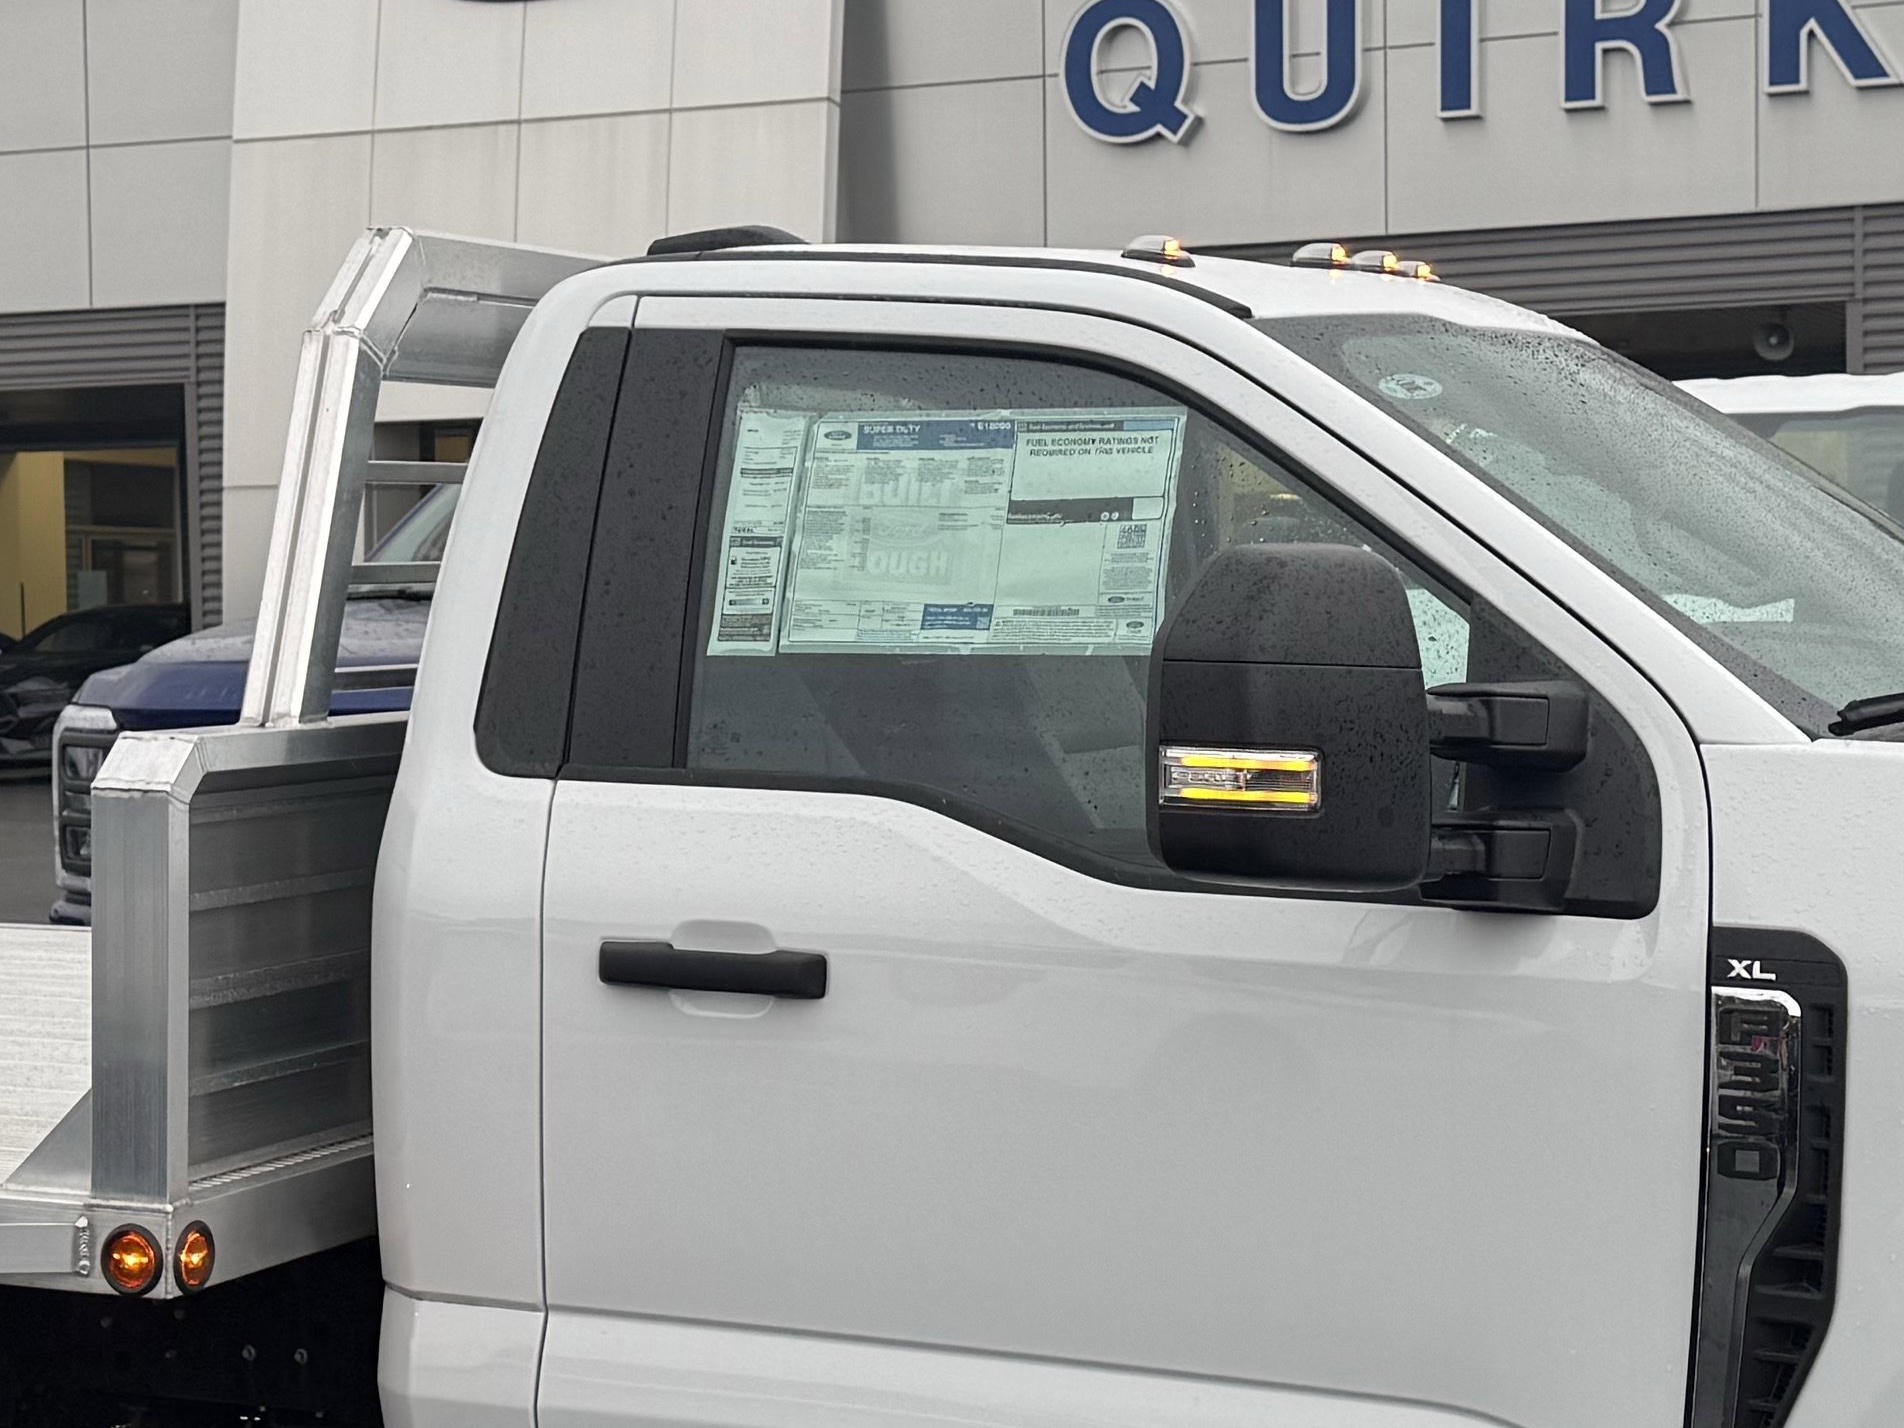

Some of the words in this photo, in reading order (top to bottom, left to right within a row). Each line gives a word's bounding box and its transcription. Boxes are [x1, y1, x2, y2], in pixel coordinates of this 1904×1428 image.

[1026, 438, 1048, 447] FUEL
[1051, 437, 1096, 447] ECONOMY
[1098, 436, 1139, 446] RATINGS
[1140, 435, 1159, 445] NOT
[1029, 448, 1077, 457] REQUIRED
[1078, 448, 1091, 456] ON
[1116, 446, 1153, 455] VEHICLE
[1727, 959, 1776, 981] XL
